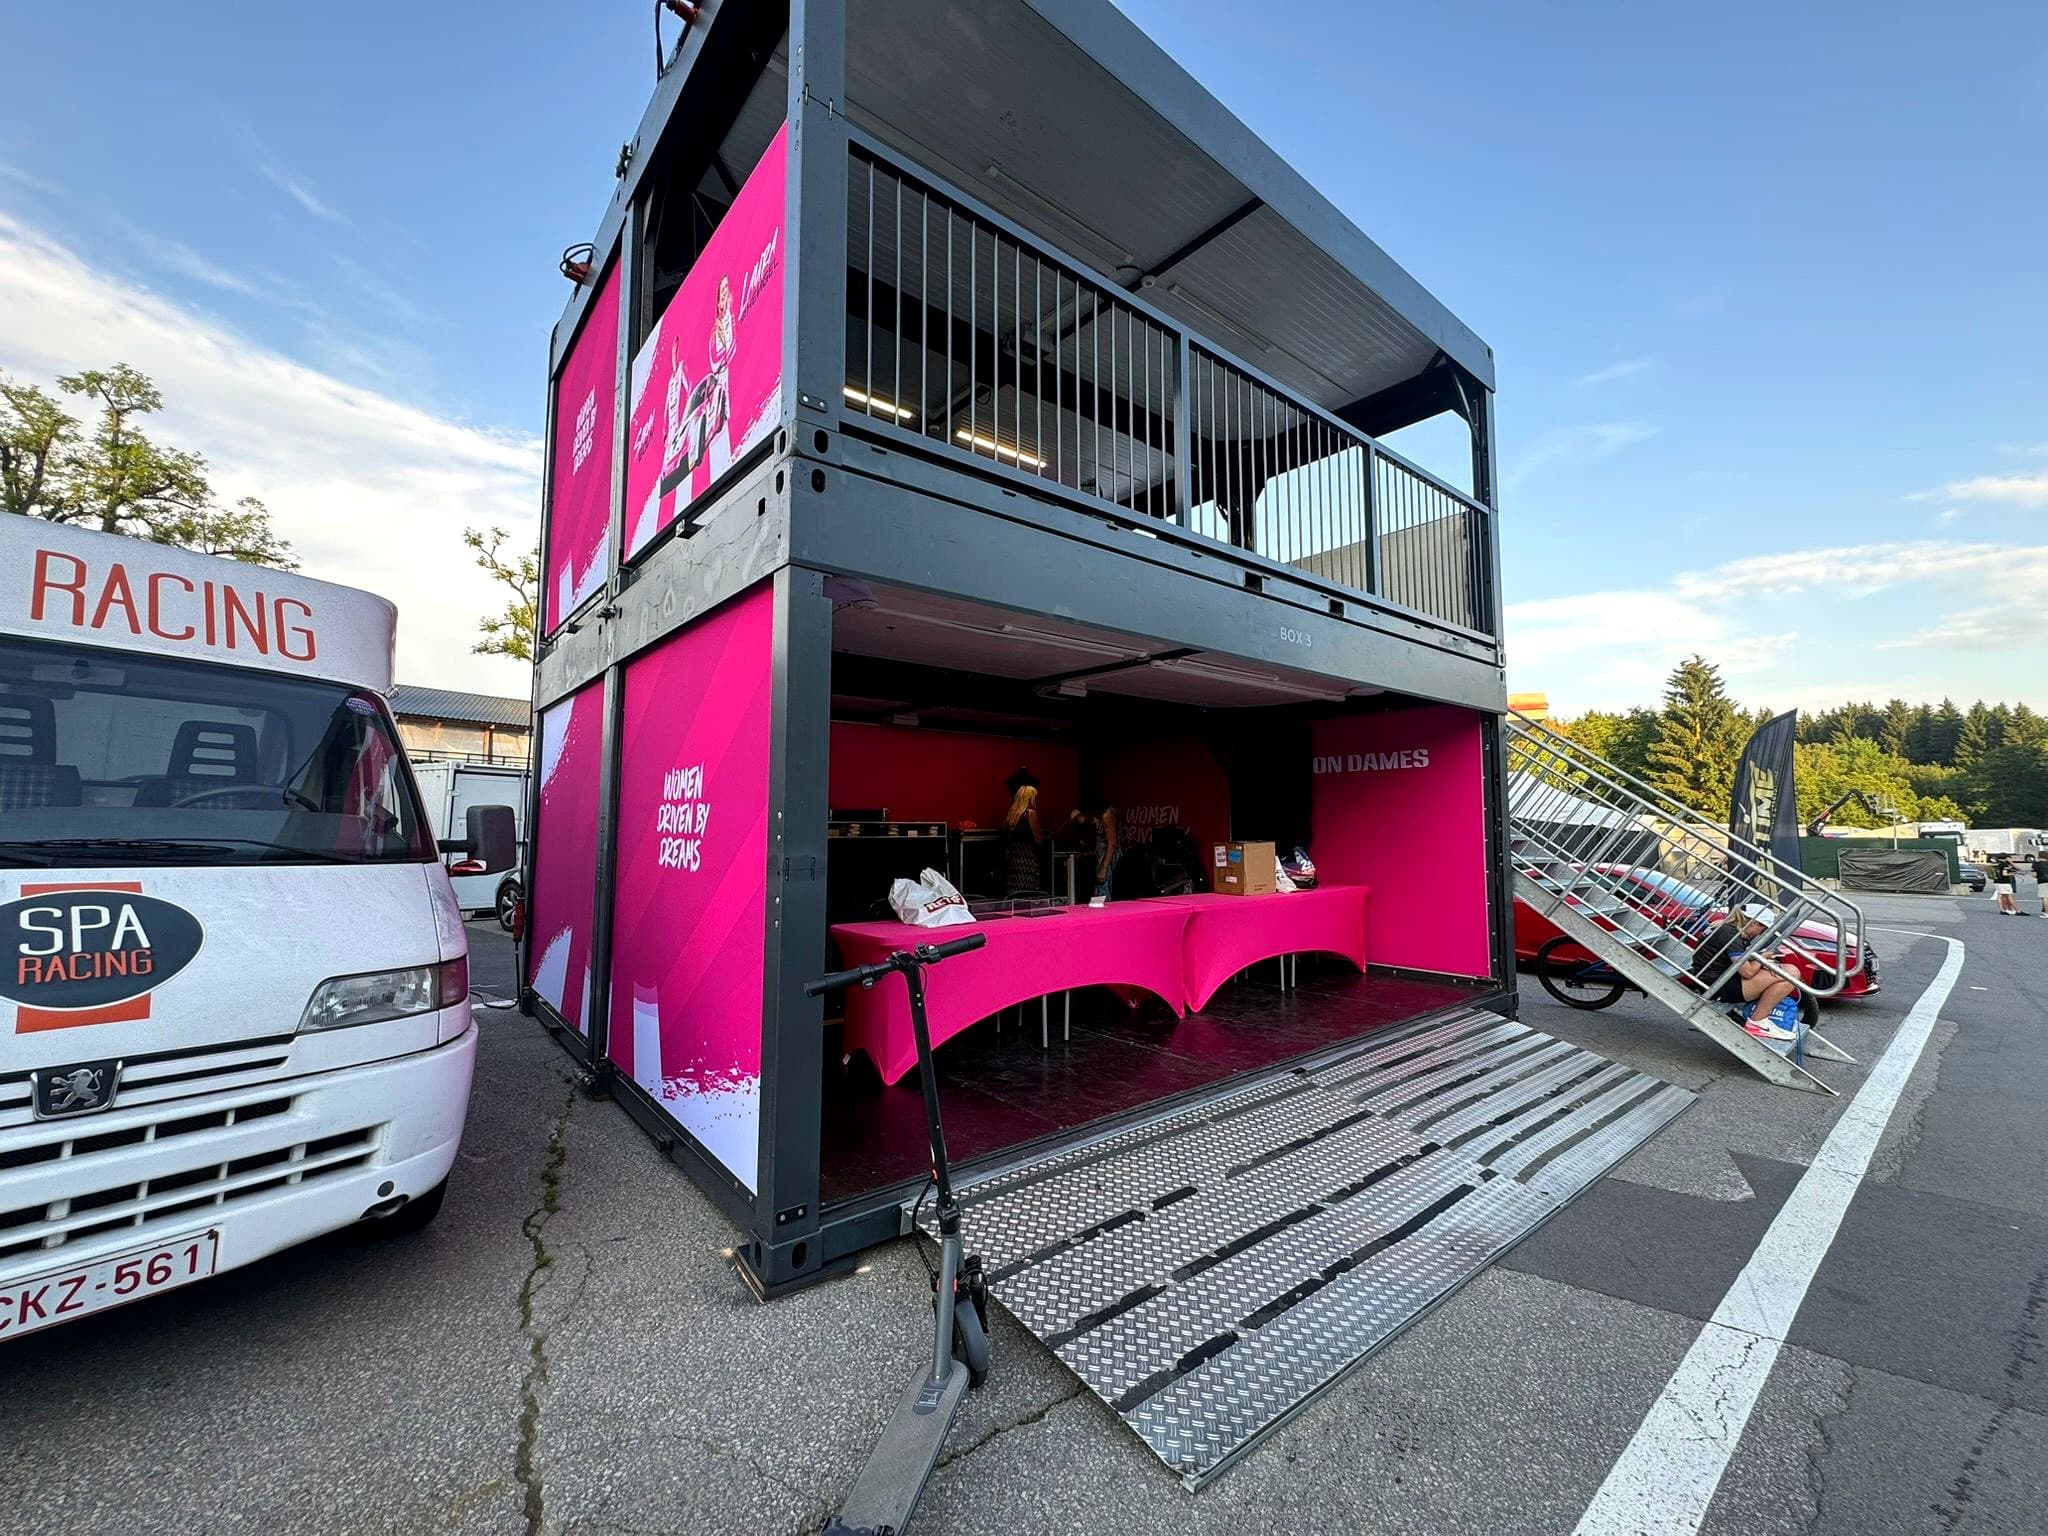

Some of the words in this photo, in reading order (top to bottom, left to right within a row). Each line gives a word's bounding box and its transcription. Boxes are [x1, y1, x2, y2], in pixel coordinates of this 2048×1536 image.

[31, 549, 317, 662] RACING
[1280, 626, 1304, 646] BOX
[1305, 633, 1312, 648] 3
[1348, 748, 1430, 772] DAMES
[663, 760, 704, 801] WOMEN
[657, 801, 694, 834] DRIVEN
[694, 803, 711, 837] BY
[1126, 805, 1179, 824] WOMEN
[658, 837, 702, 872] DREAMS
[19, 904, 151, 956] SPA
[18, 950, 153, 985] RACING
